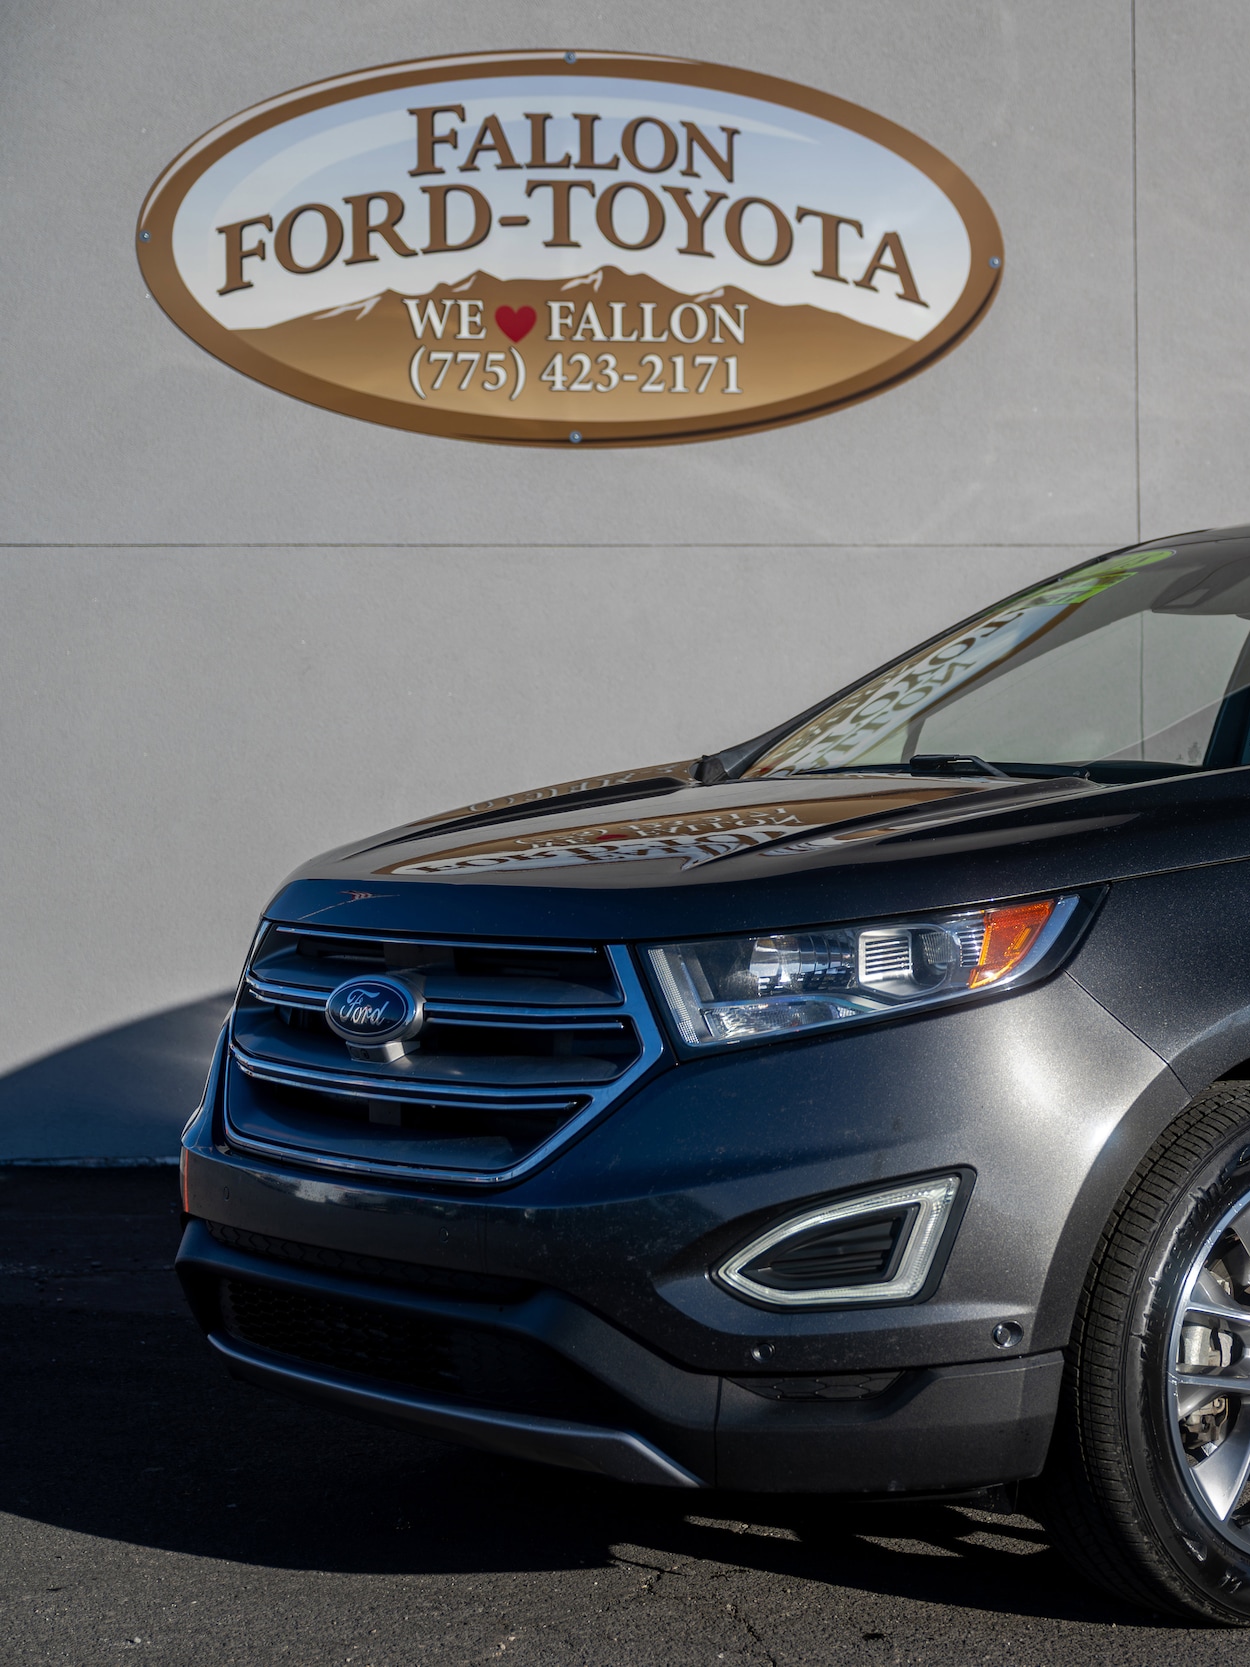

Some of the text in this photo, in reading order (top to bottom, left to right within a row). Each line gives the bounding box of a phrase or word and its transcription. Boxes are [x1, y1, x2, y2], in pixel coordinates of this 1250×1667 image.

[408, 103, 741, 182] FALLON
[216, 180, 930, 309] FORD-TOYOTA
[404, 300, 749, 344] WE FALLON
[410, 345, 743, 400] (775) 423-2171
[339, 988, 390, 1026] Ford
